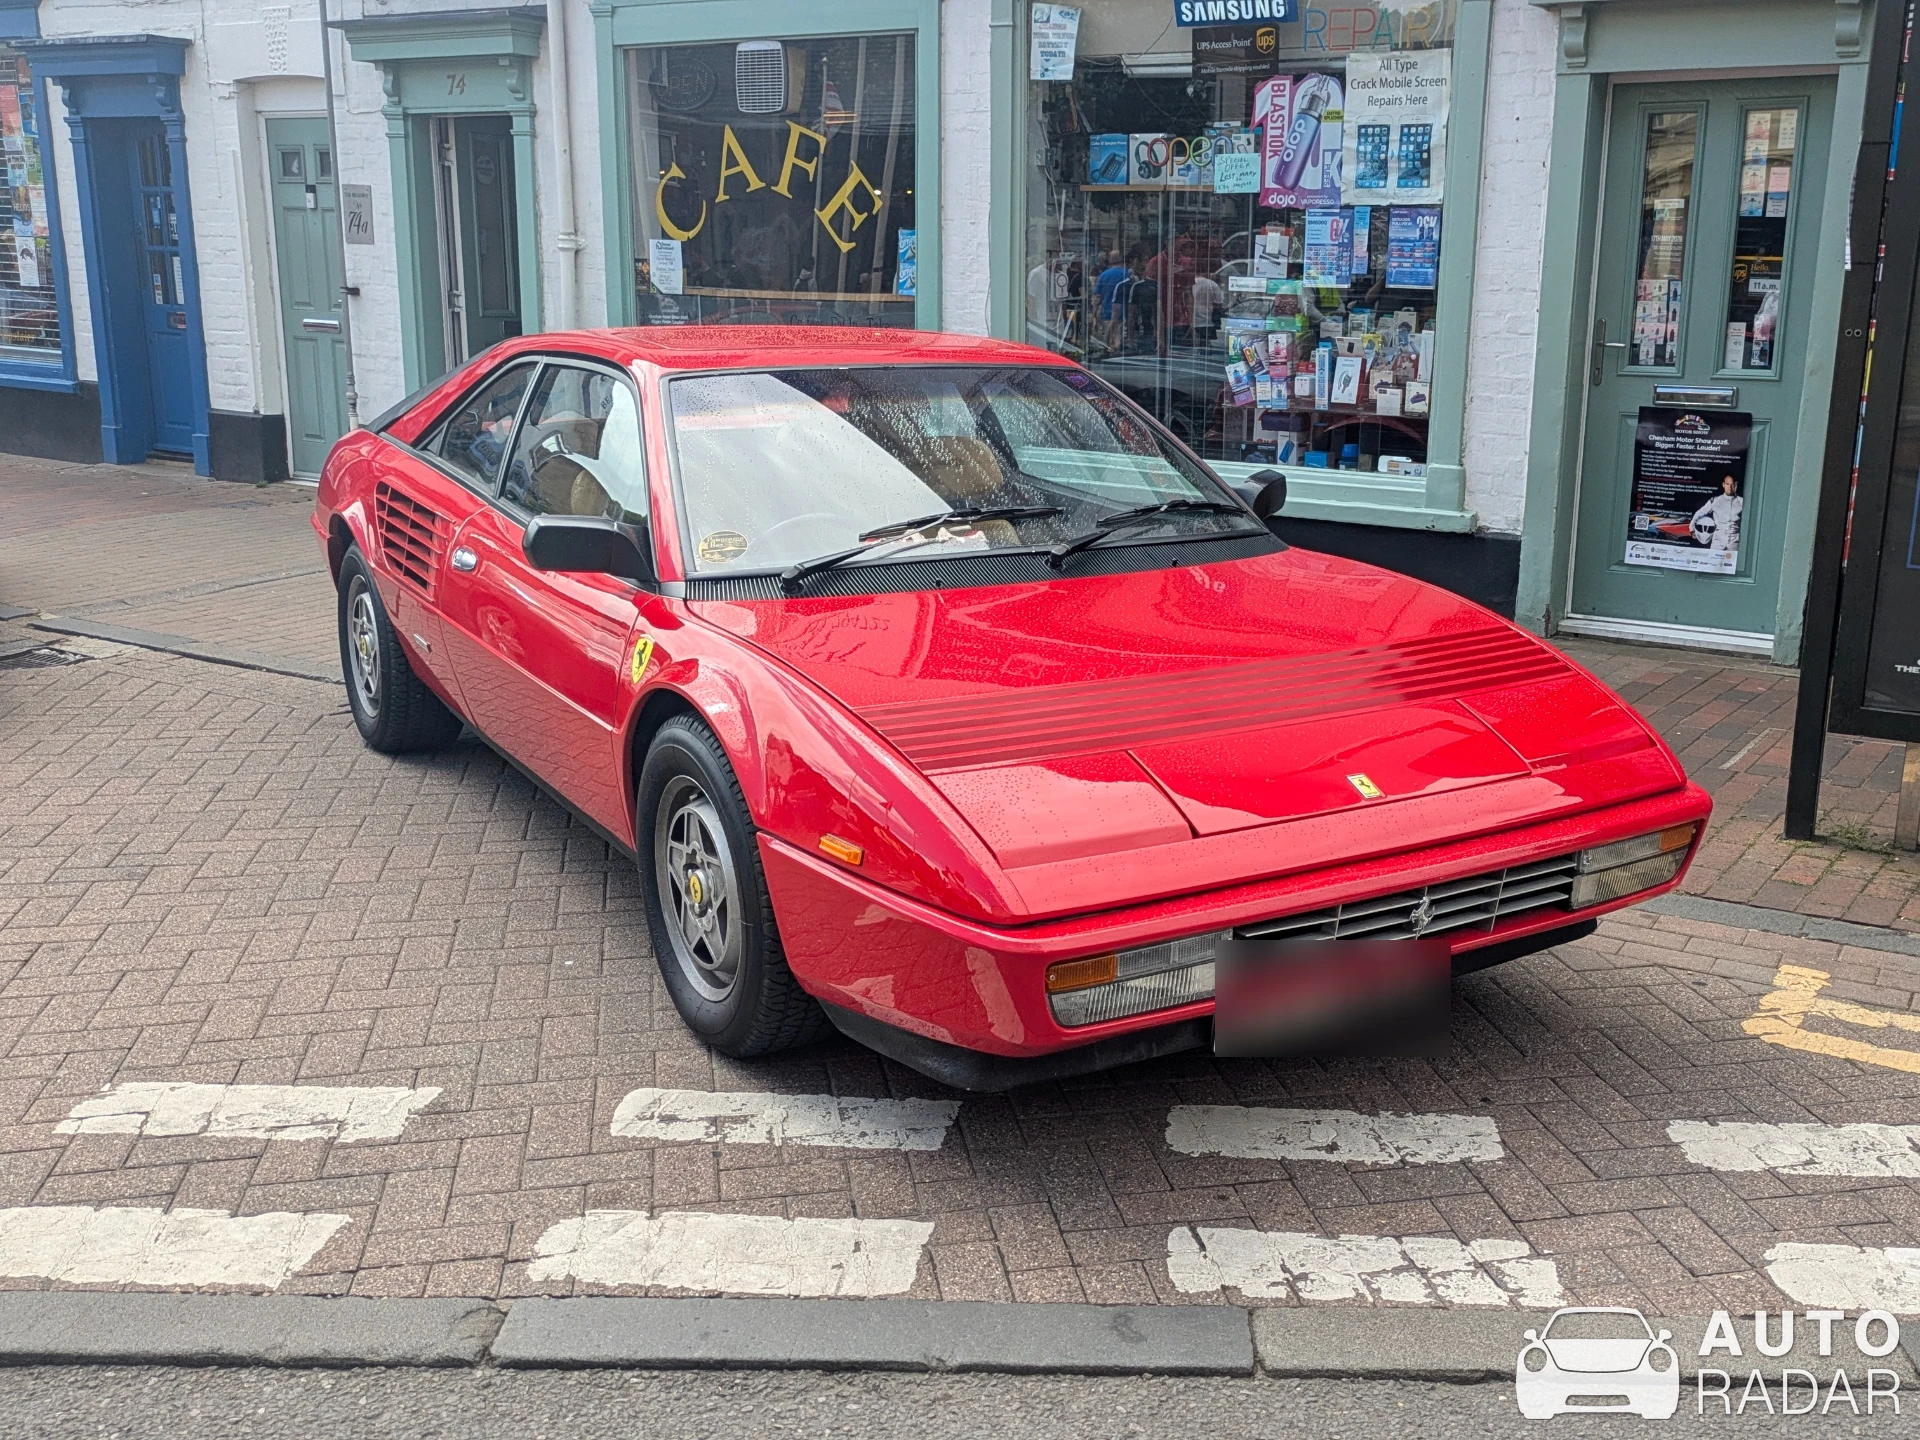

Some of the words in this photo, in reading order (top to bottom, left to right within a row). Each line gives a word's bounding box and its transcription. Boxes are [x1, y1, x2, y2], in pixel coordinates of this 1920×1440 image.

[1181, 0, 1285, 22] SAMSUNG
[1304, 6, 1432, 52] REPAIR
[1196, 42, 1210, 50] UPS
[1211, 41, 1232, 49] Access
[1232, 39, 1251, 47] Point
[1258, 35, 1274, 50] ups
[1233, 64, 1252, 72] shipping
[1379, 59, 1392, 71] All
[1394, 59, 1418, 73] Type
[447, 73, 466, 96] 74
[1350, 77, 1376, 90] Crack
[1379, 76, 1412, 89] Mobile
[1415, 76, 1447, 88] Screen
[1367, 95, 1403, 109] Repairs
[1405, 94, 1428, 106] Here
[1283, 119, 1306, 162] dojo
[1147, 135, 1233, 177] open
[1224, 163, 1250, 172] OFFER
[1323, 163, 1331, 187] PUFFS
[655, 119, 884, 253] CAFE
[1268, 193, 1296, 207] dojo
[13, 203, 31, 212] HELIOS
[348, 211, 369, 234] 74a
[1648, 434, 1675, 442] Chesham
[1655, 441, 1675, 449] Bigger.
[1894, 664, 1920, 674] THE
